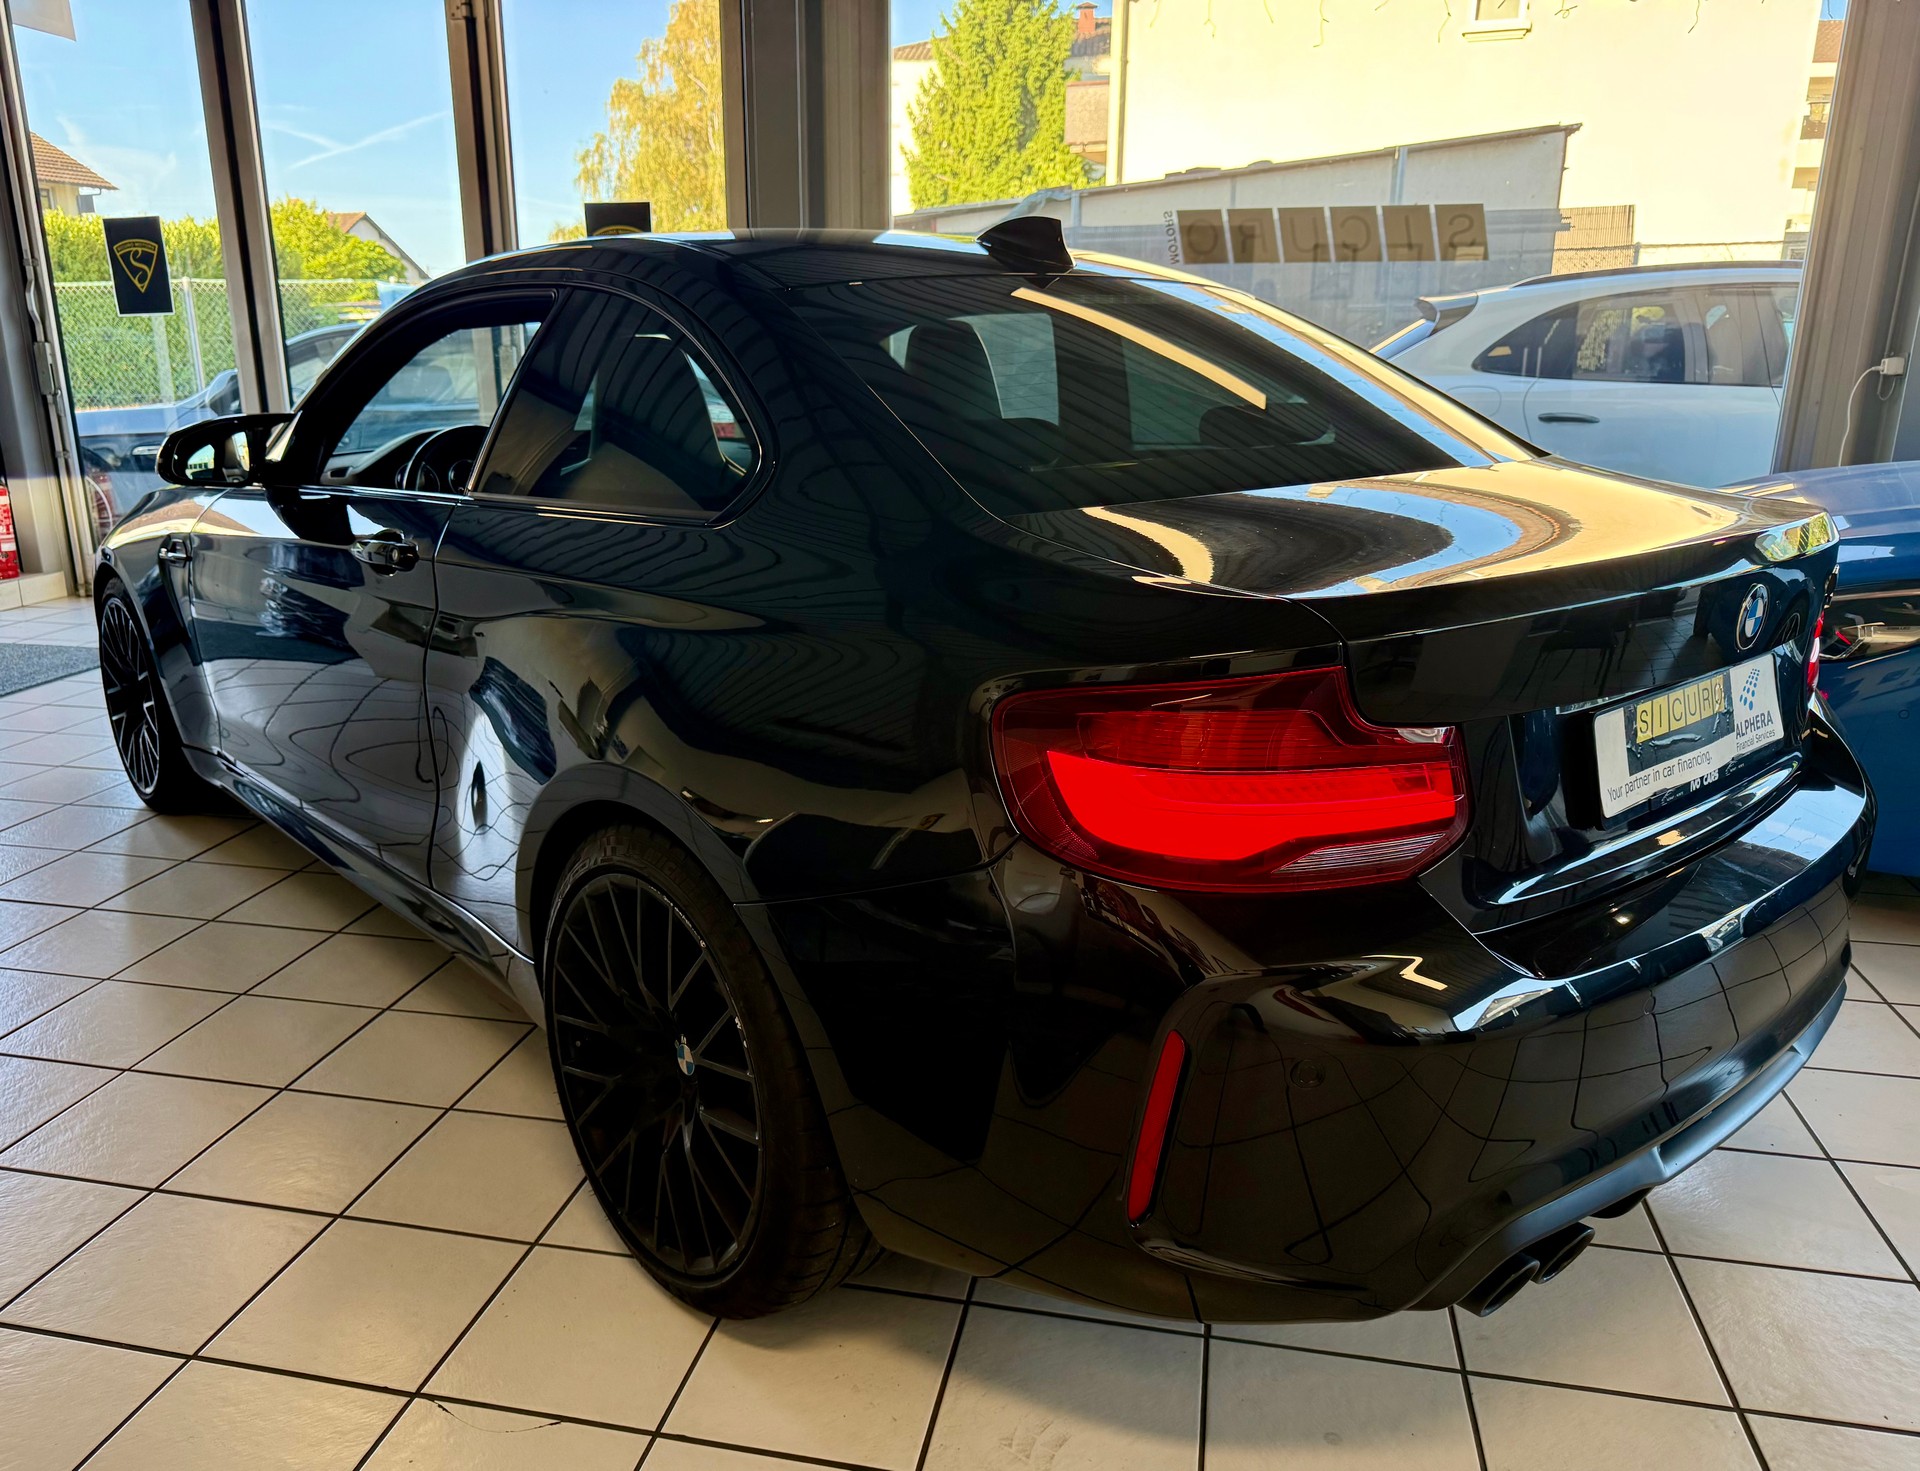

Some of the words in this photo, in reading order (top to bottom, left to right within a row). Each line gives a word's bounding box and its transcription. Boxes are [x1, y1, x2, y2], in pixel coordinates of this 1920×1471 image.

[1639, 683, 1724, 735] SICURO
[1735, 710, 1774, 740] ALPHERA
[1736, 734, 1755, 752] Financial
[1755, 728, 1776, 747] Services
[1607, 784, 1624, 803] Your
[1625, 772, 1651, 798] partner
[1653, 769, 1661, 783] in
[1662, 763, 1676, 778] car
[1678, 750, 1713, 773] financing.
